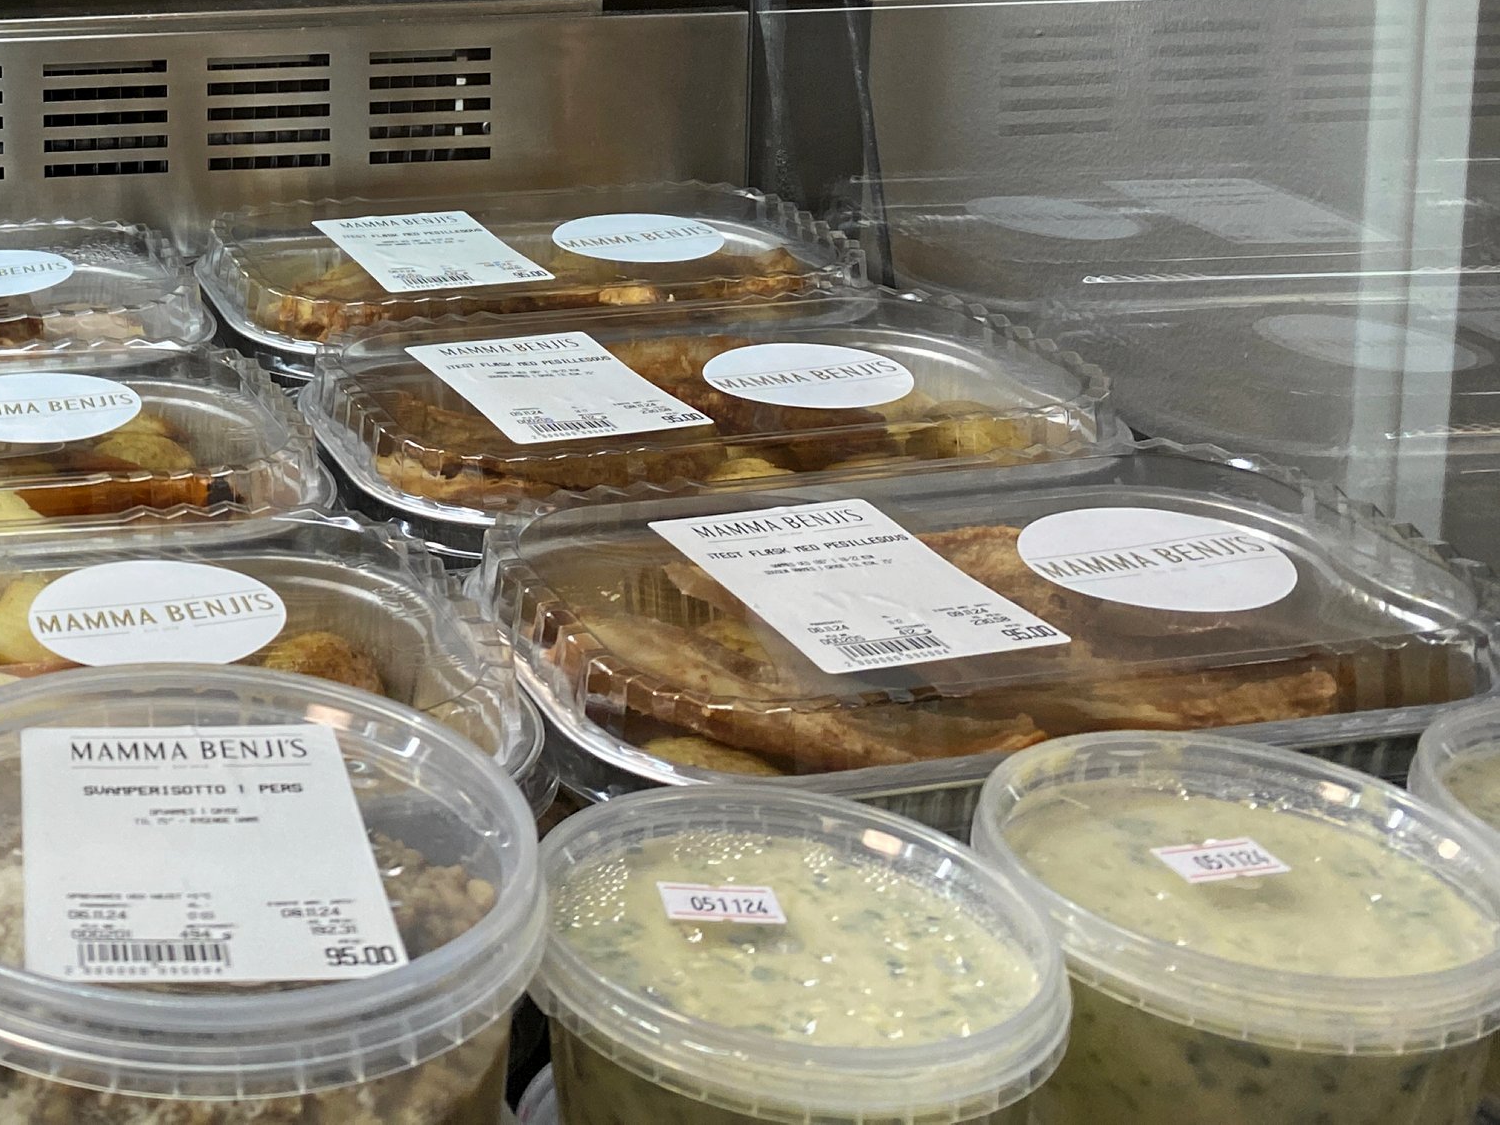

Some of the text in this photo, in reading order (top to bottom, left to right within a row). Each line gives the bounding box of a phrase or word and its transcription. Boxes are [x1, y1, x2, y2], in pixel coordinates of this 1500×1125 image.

[340, 216, 458, 230] MAMMA BENJI'S
[560, 225, 713, 249] MAMMA BENJI'S
[439, 339, 580, 357] MAMMA BENJI'S
[712, 360, 898, 390] MAMMA BENJI'S
[48, 393, 134, 412] BENJI'S
[661, 413, 705, 423] 95.00
[692, 508, 864, 539] MAMMA BENJI'S
[794, 544, 821, 553] MED
[1034, 535, 1265, 579] MAMMA BENJI'S
[36, 593, 274, 634] MAMMA BENJI'S
[1001, 625, 1058, 641] 95.00
[71, 738, 308, 761] MAMMA BENJI'S
[83, 784, 226, 796] SVAMPERISOTTO
[258, 783, 303, 794] PERS
[691, 896, 768, 914] 051124
[325, 945, 397, 966] 95.00
